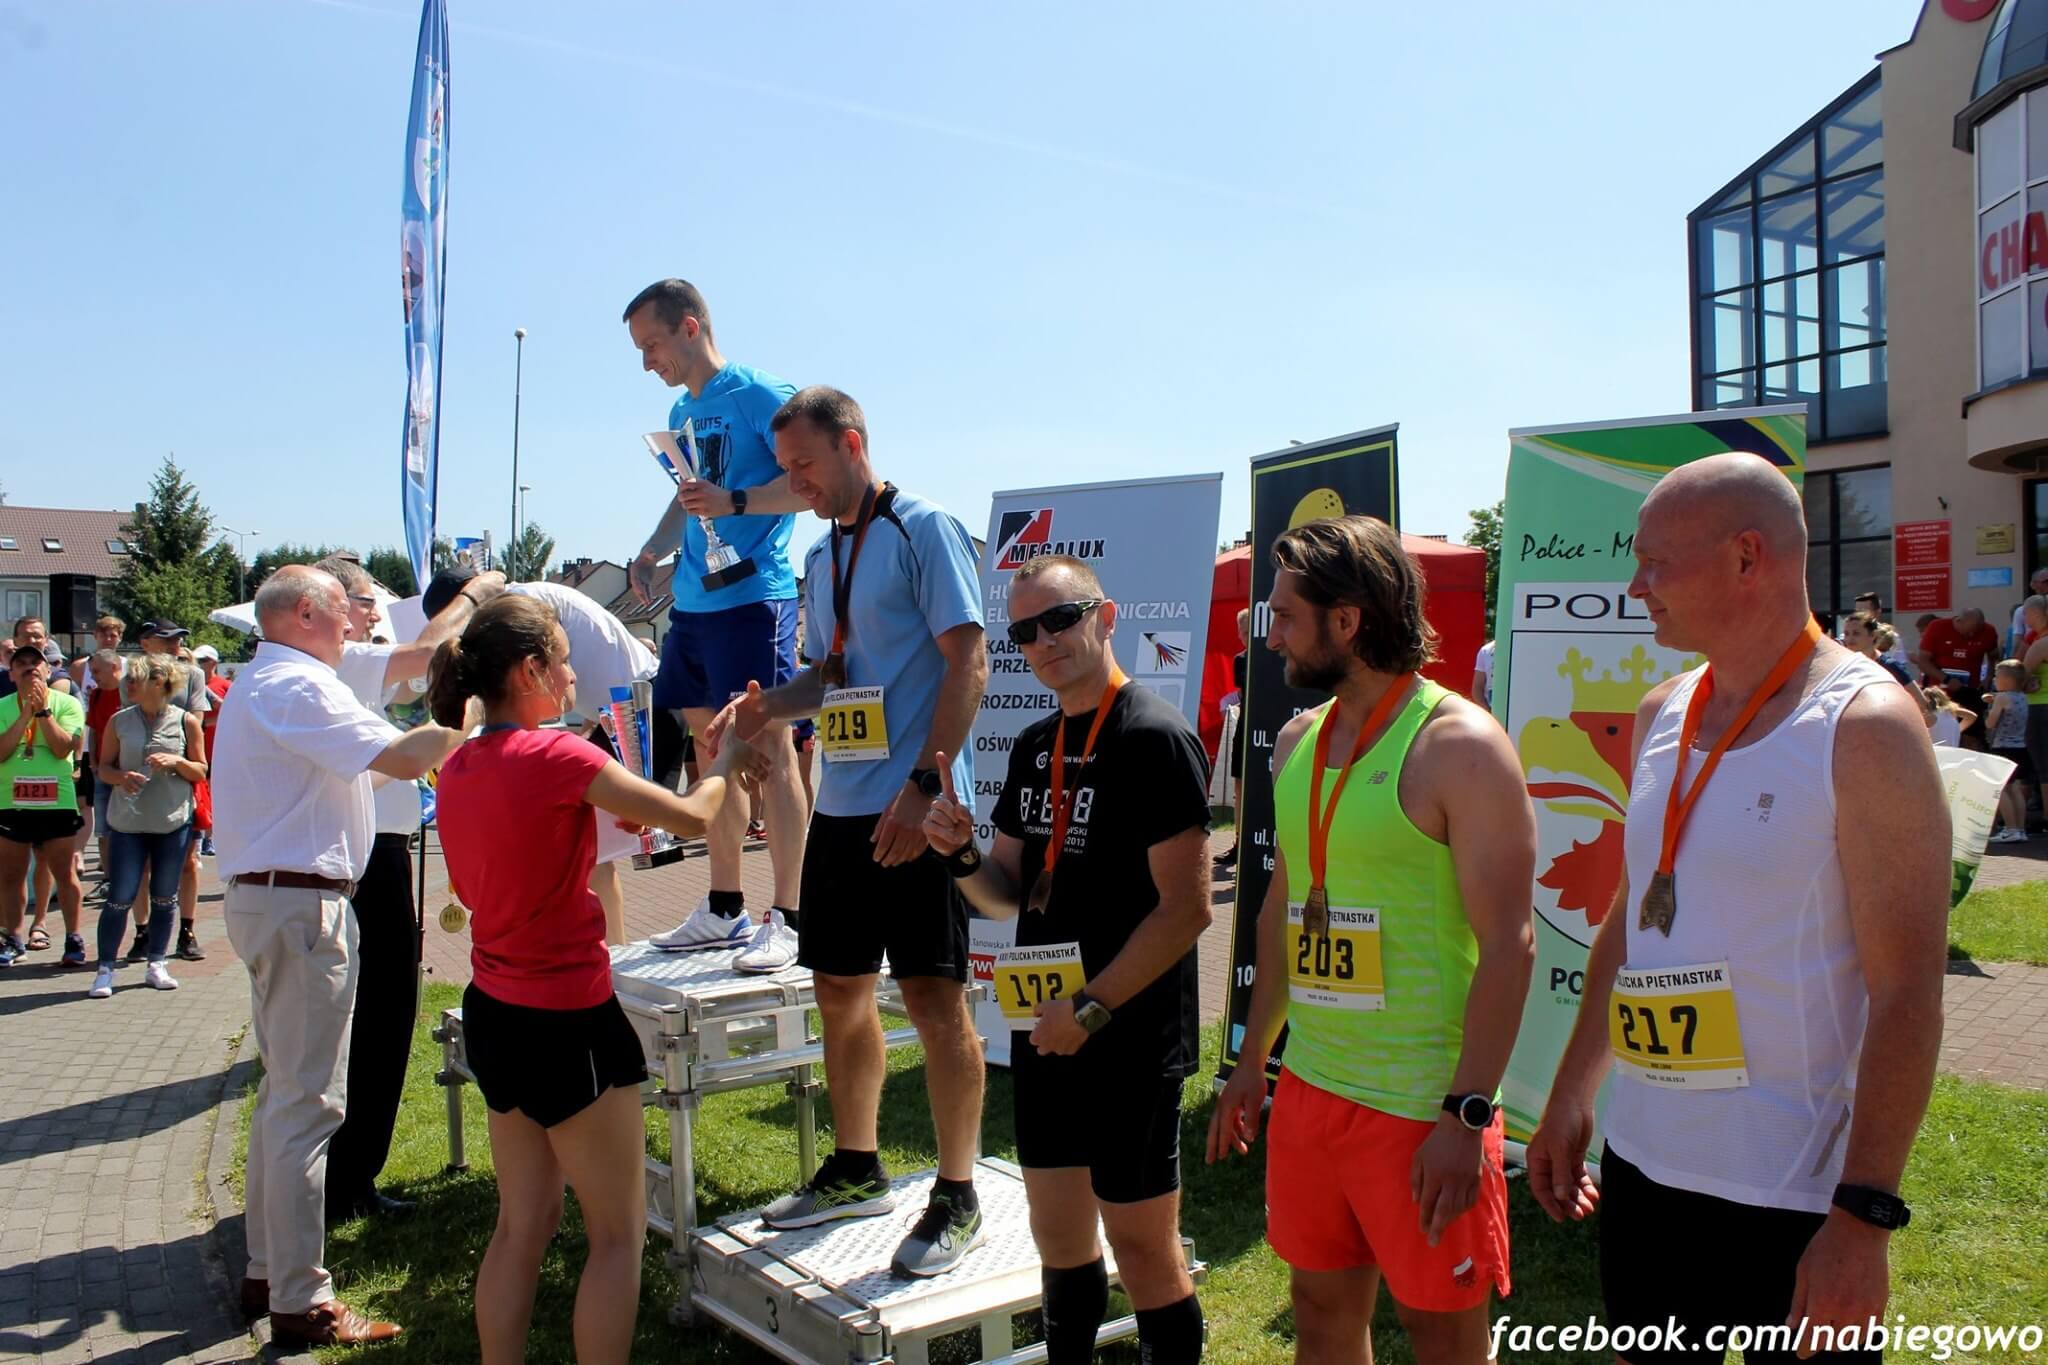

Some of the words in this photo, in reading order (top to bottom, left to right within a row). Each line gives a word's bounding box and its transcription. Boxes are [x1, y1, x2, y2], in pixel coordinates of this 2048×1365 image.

[1008, 539, 1105, 562] MEGALUX
[1520, 533, 1585, 562] Police
[828, 710, 867, 742] 219
[14, 784, 49, 799] 1121
[1254, 829, 1270, 846] ul.
[1297, 934, 1355, 981] 203
[1645, 969, 1723, 990] PIĘTNASTKA
[1617, 1003, 1698, 1056] 217
[765, 1295, 780, 1335] 3
